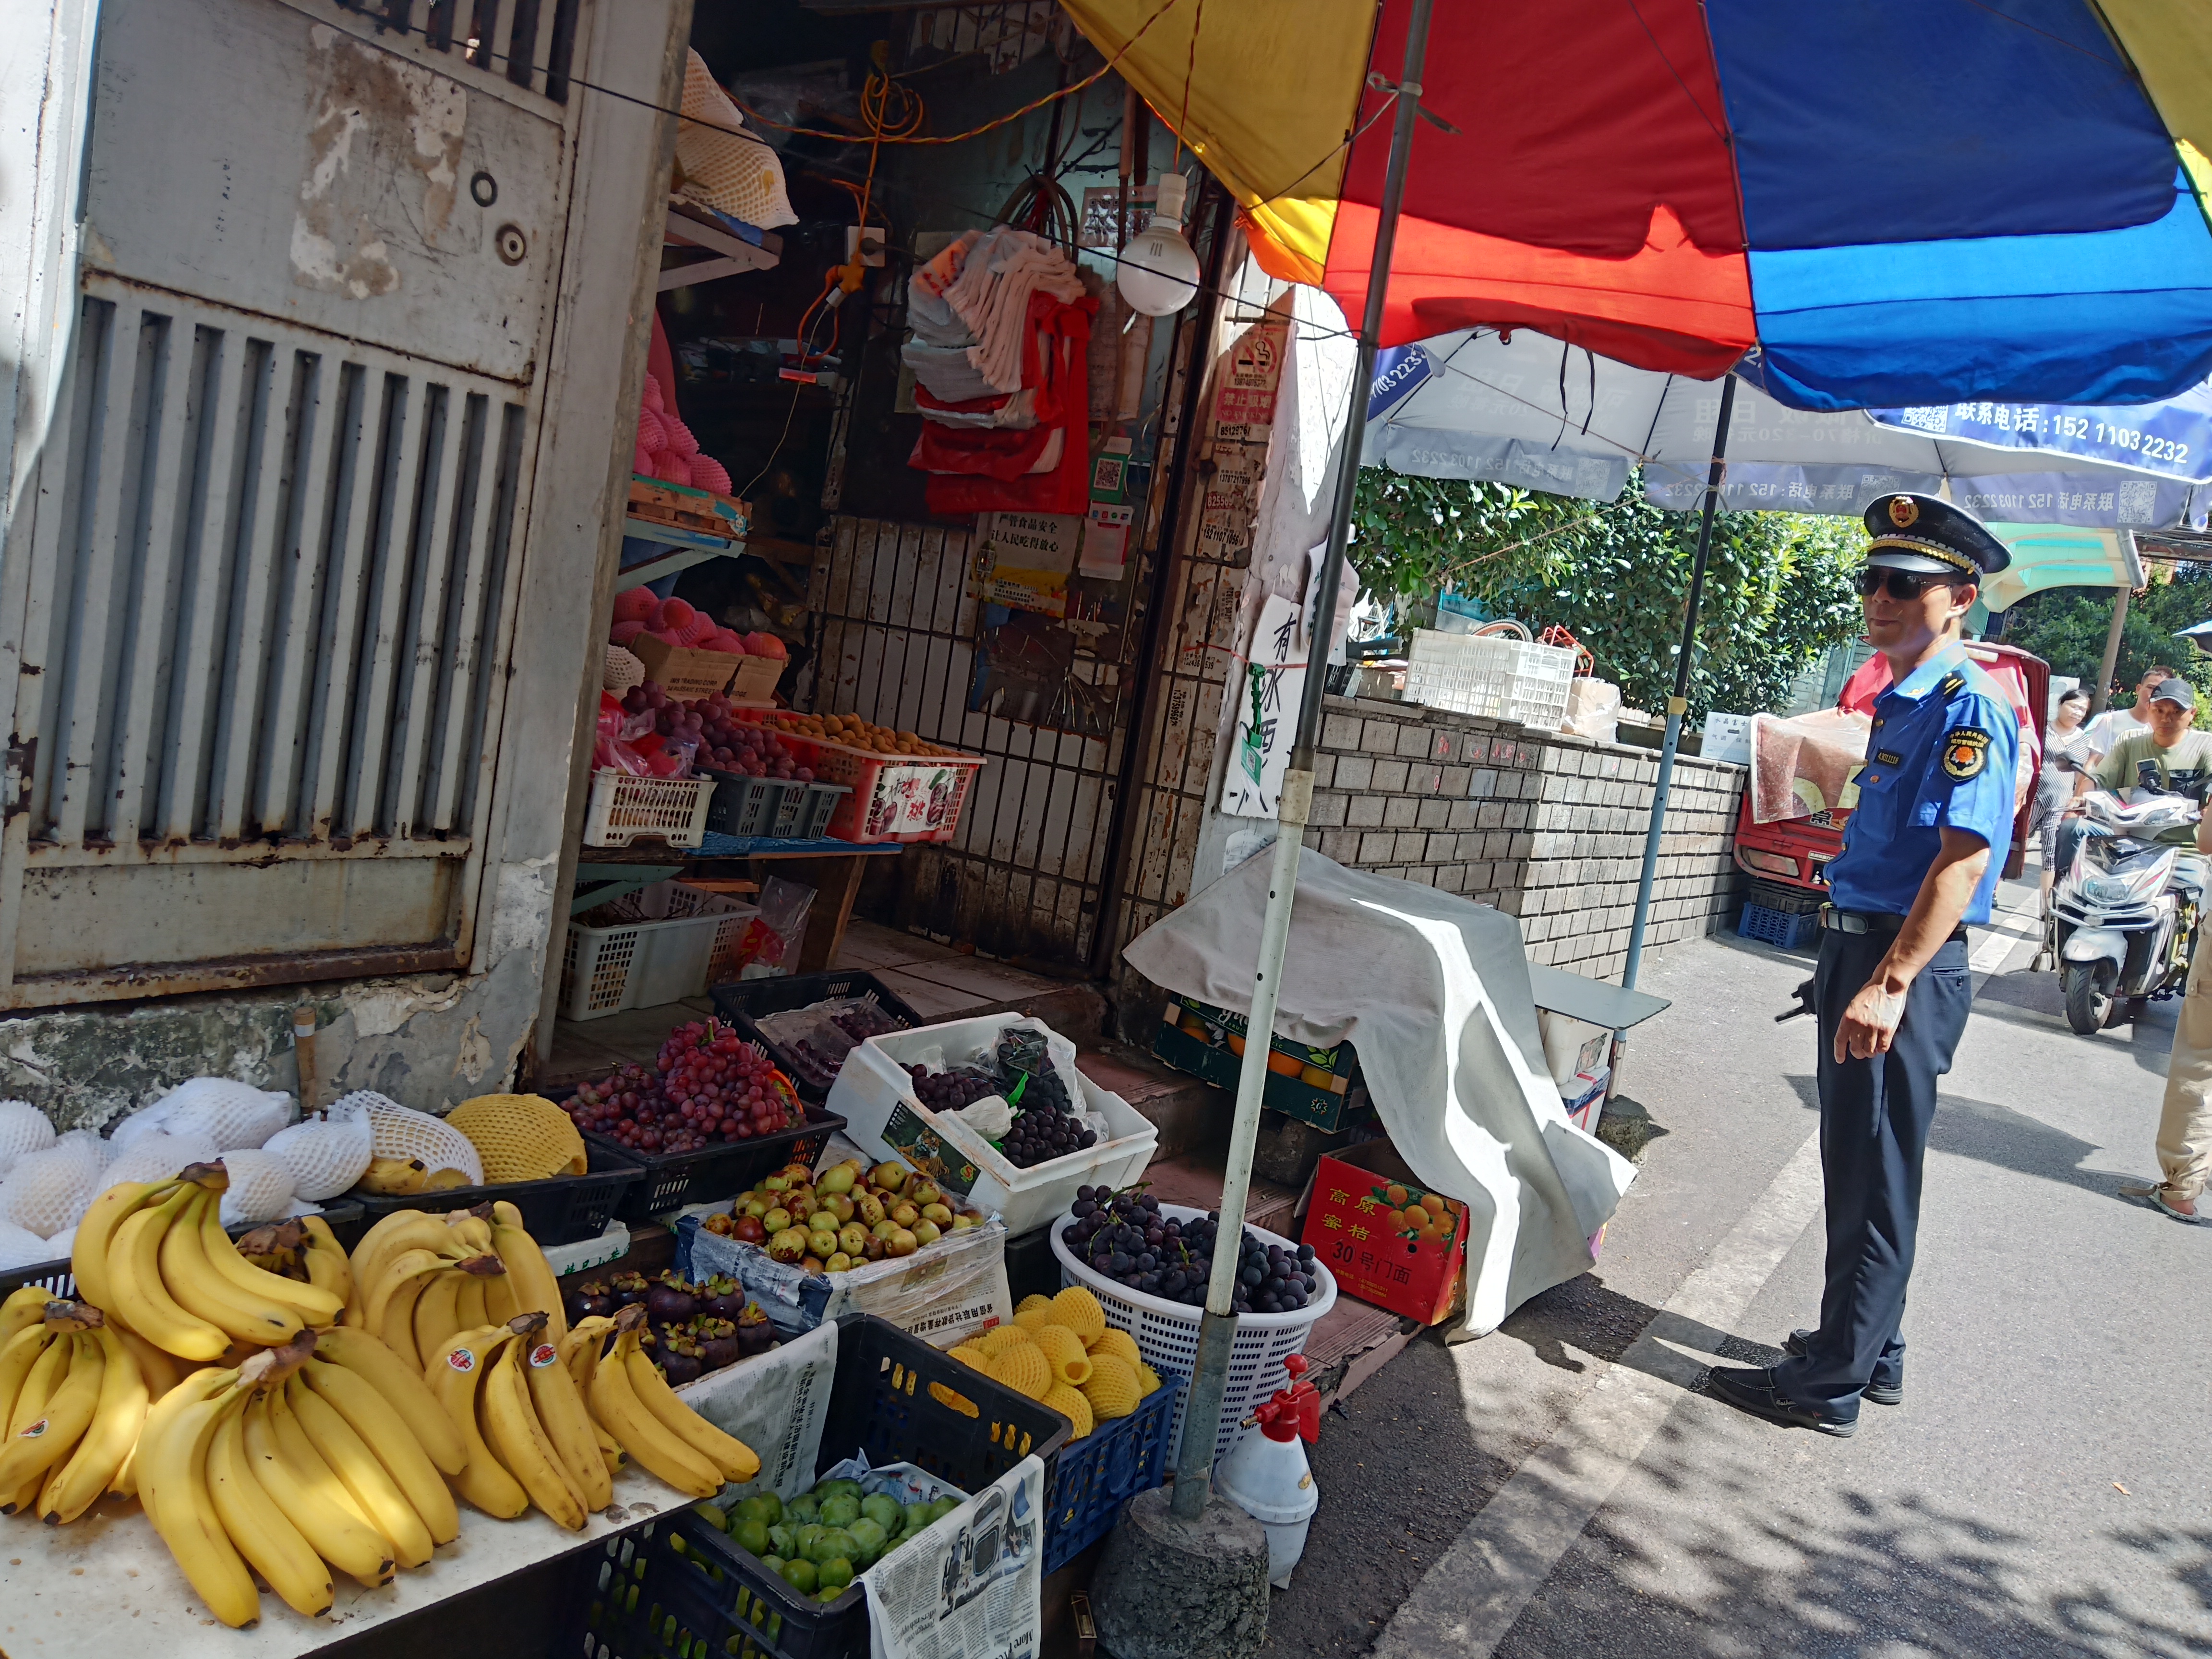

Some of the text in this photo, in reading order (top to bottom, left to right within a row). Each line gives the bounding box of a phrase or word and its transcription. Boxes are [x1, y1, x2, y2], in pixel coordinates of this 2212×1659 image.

[1224, 392, 1272, 409] 禁止吸烟
[999, 514, 1058, 534] 严管食品安全
[991, 529, 1058, 552] 让人民吃得放心
[1715, 717, 1747, 726] 水晶富士
[1329, 1188, 1376, 1217] 高原
[1322, 1213, 1370, 1241] 蜜桔
[1014, 1628, 1034, 1649] More
